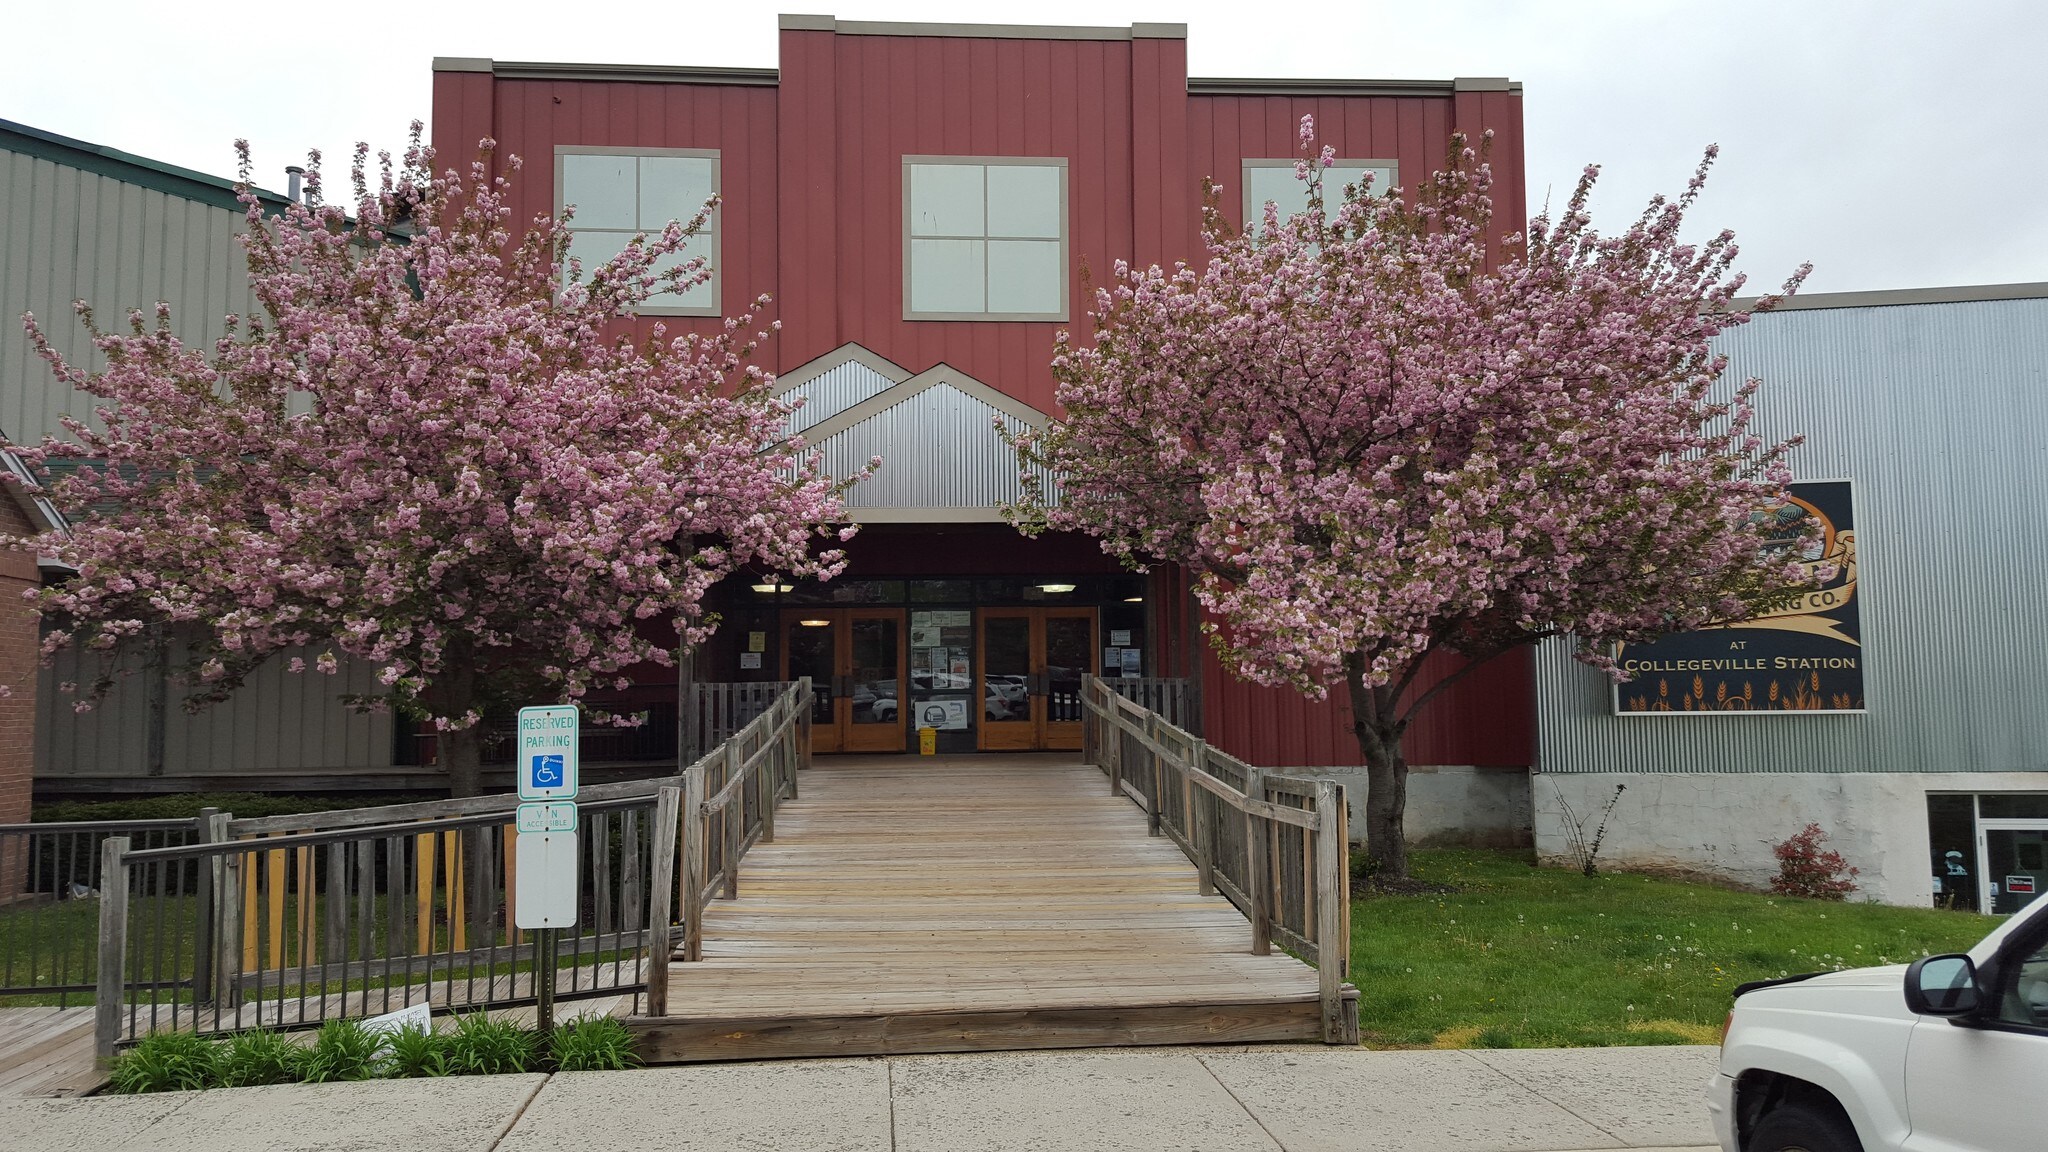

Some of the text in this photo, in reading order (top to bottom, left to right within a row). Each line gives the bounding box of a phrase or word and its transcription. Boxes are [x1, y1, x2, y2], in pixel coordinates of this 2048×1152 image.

[1809, 592, 1840, 607] CO.
[1730, 641, 1747, 649] AT
[1625, 656, 1856, 671] COLLEGEVILLE STATION
[523, 717, 573, 730] RESERVED
[526, 735, 570, 748] PARKING
[537, 809, 557, 818] VN
[527, 819, 567, 827] ACCESIBLE
